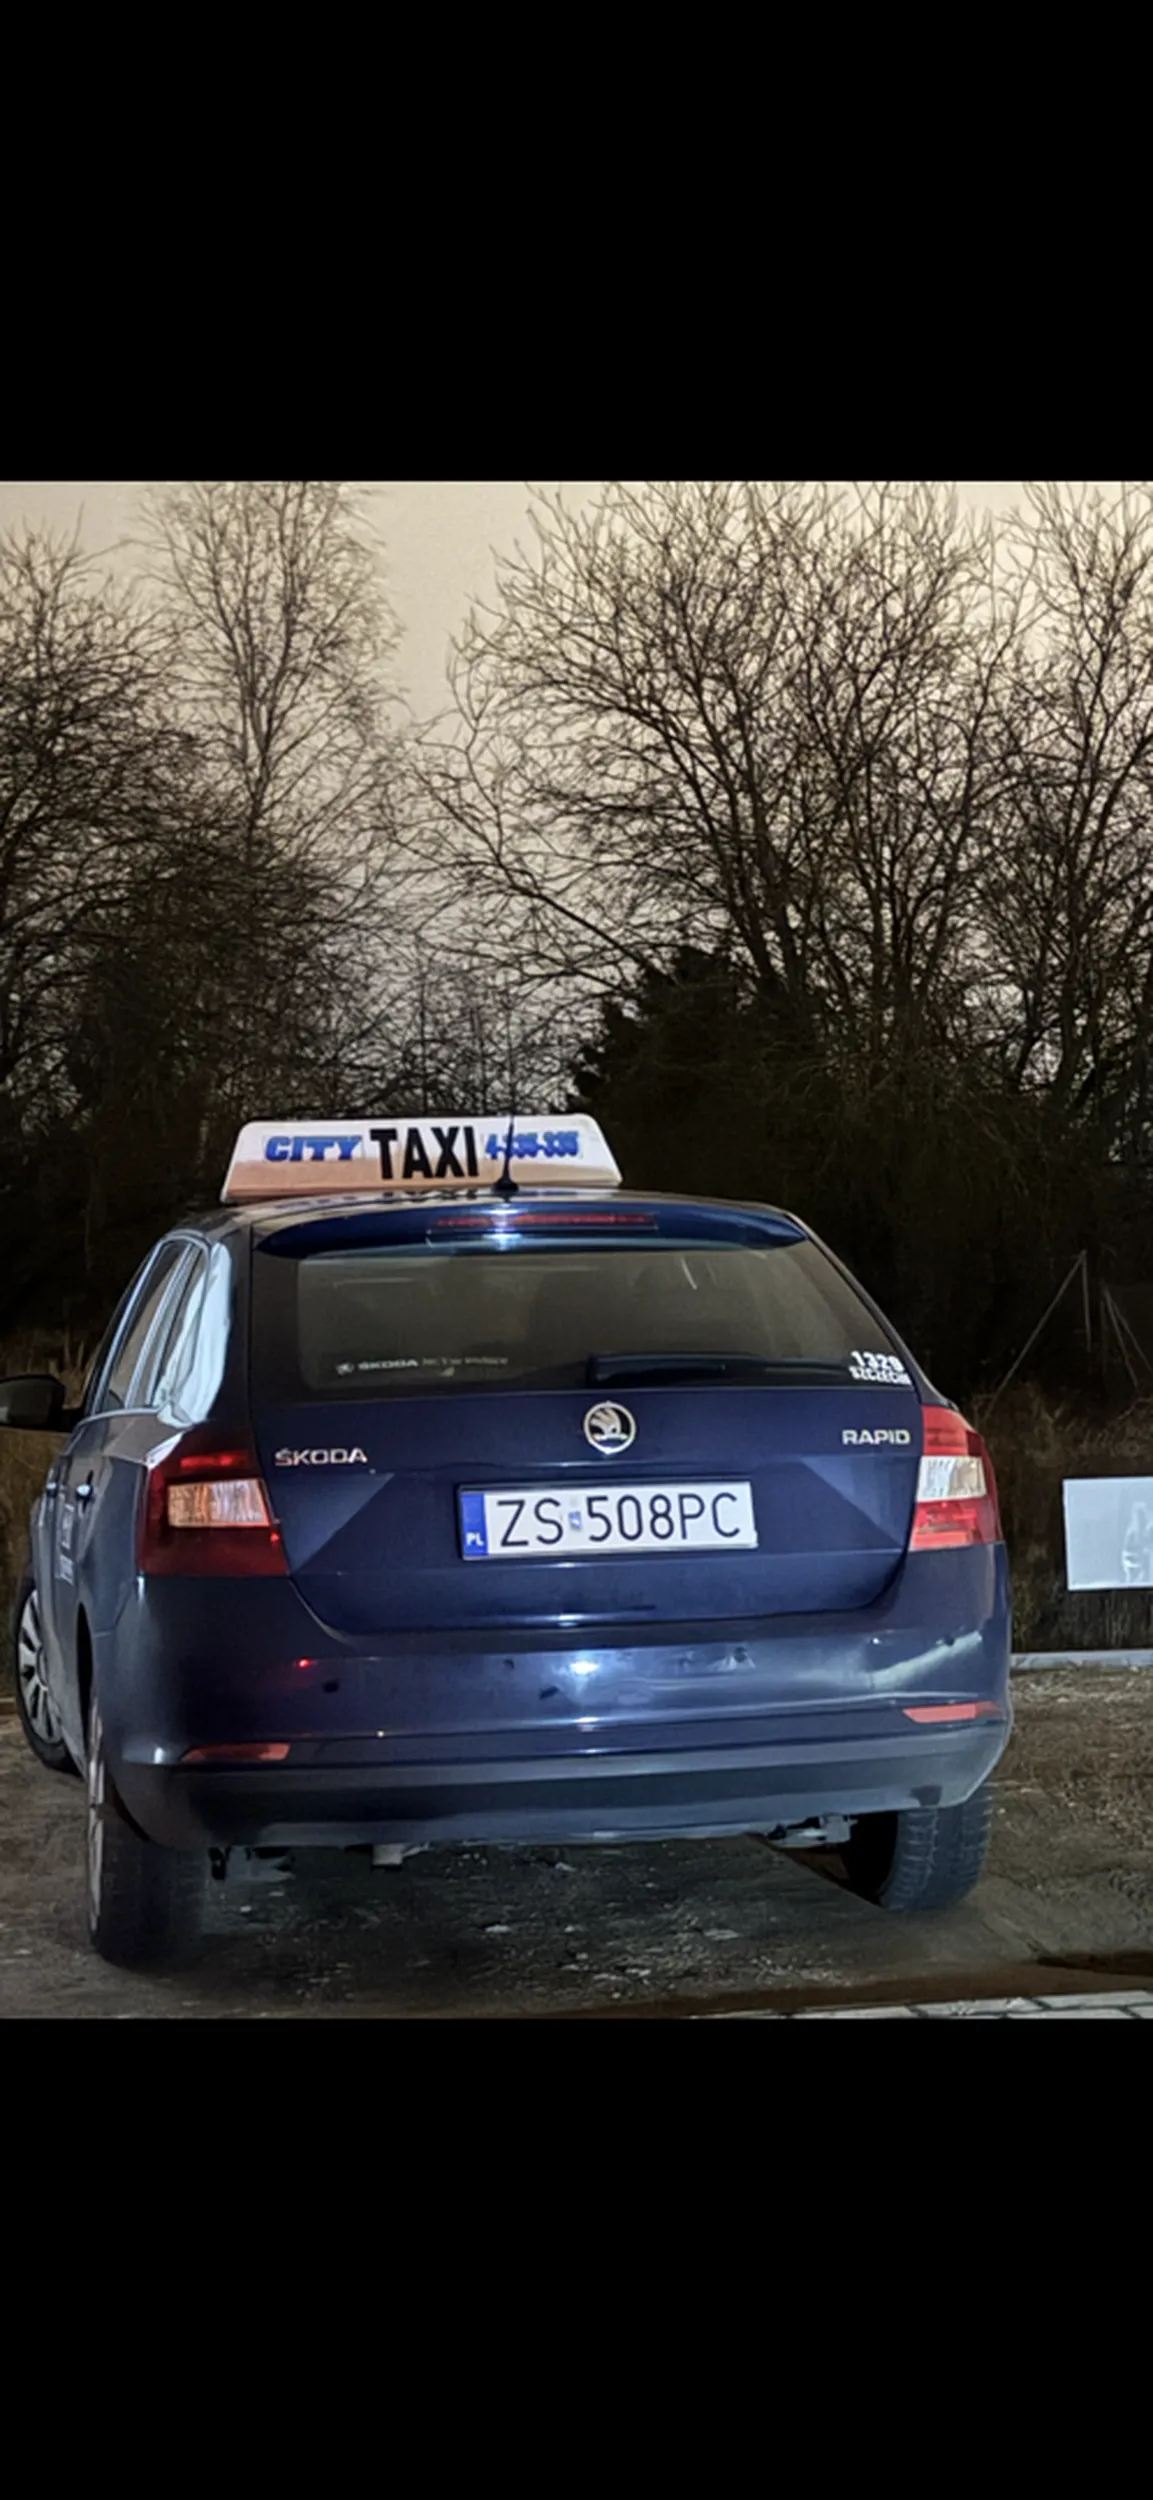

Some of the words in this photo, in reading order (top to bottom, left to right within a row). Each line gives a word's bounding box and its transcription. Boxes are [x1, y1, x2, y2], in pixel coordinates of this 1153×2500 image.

[264, 1134, 362, 1162] CITY
[370, 1125, 481, 1180] TAXI
[842, 1428, 911, 1445] RAPID
[274, 1446, 368, 1467] ŠKODA
[496, 1497, 564, 1548] ZS
[586, 1492, 741, 1542] 508PC
[465, 1533, 484, 1546] PL
